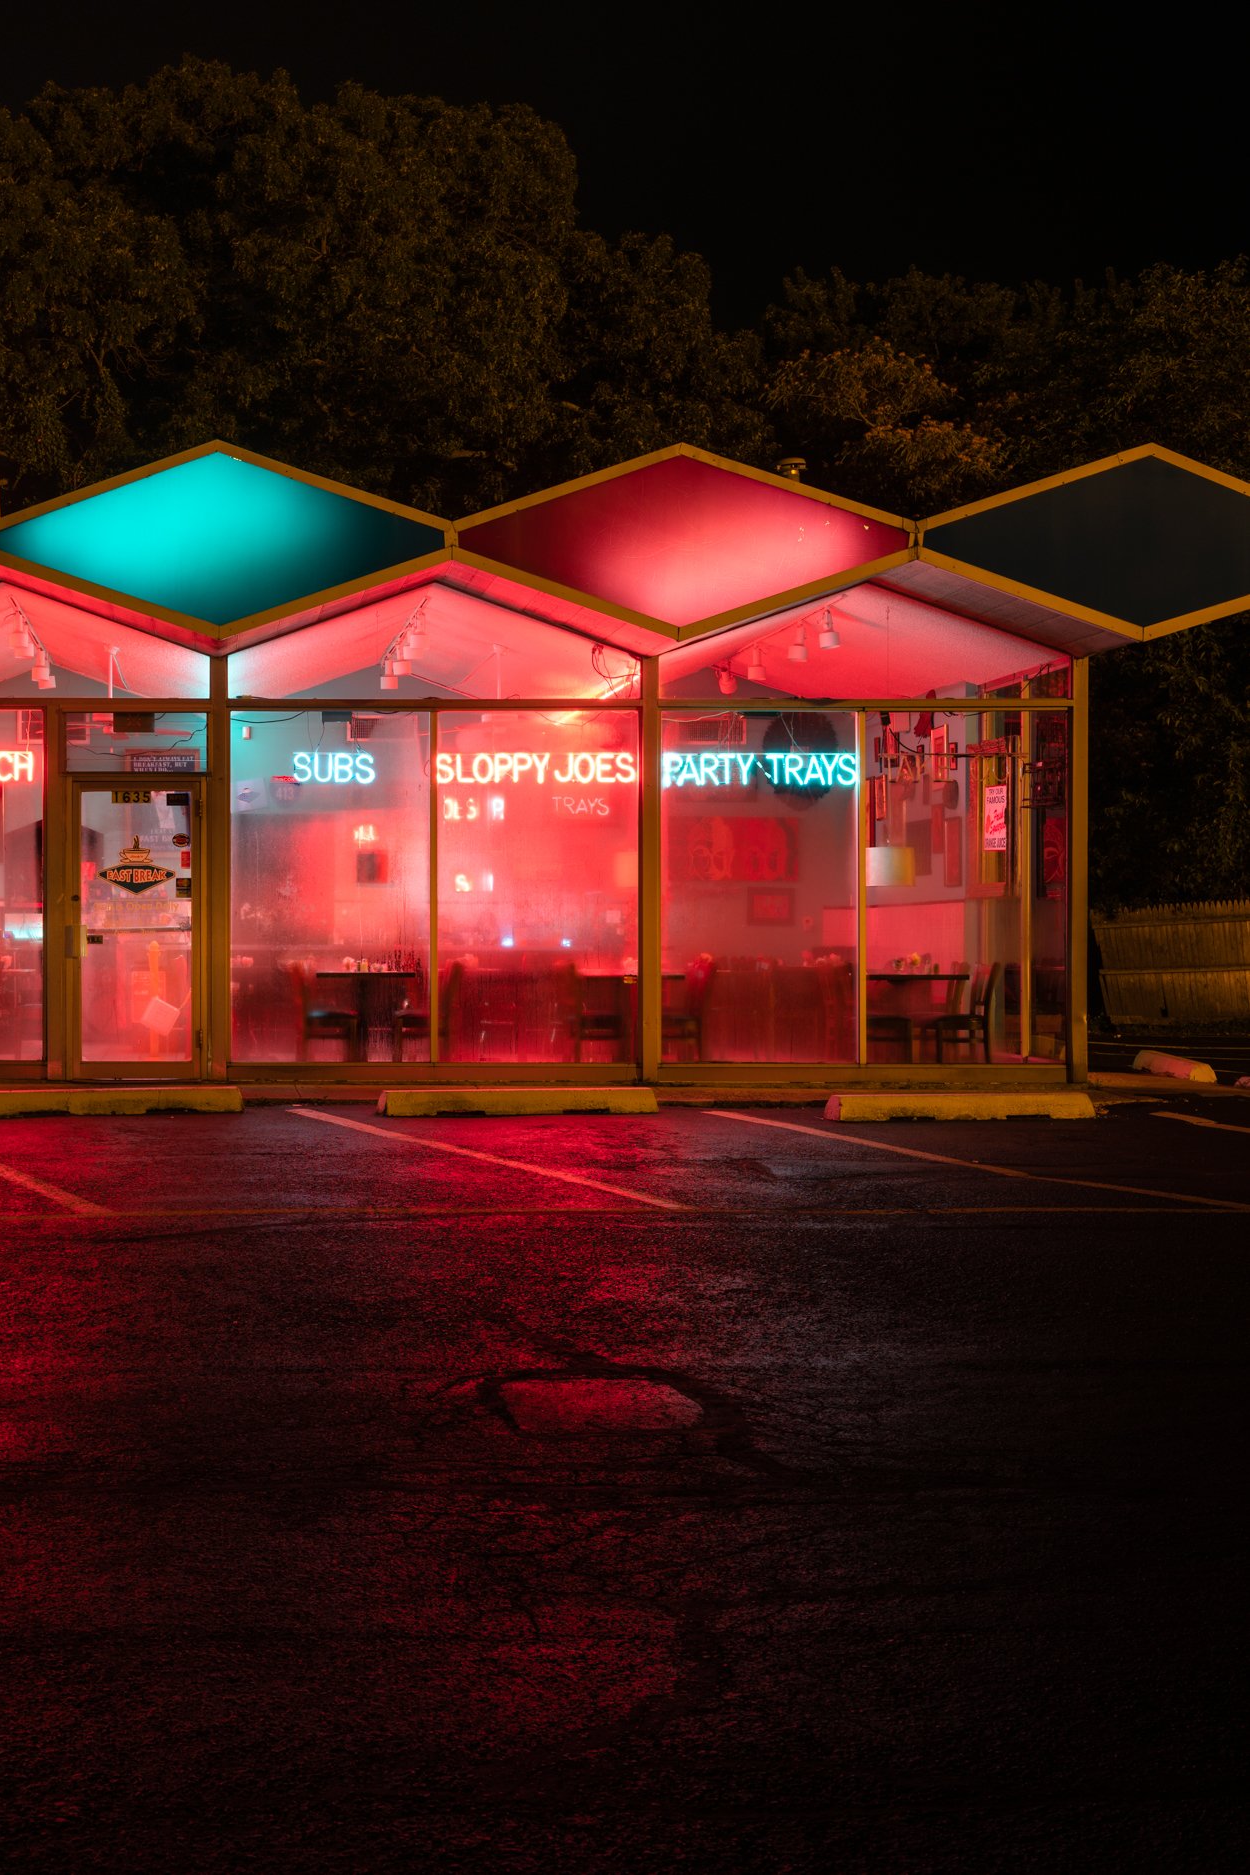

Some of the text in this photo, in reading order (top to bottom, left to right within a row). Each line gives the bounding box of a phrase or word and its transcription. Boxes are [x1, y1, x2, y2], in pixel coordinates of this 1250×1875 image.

[293, 752, 376, 784] SUBS
[436, 753, 636, 784] SLOPPY JOES
[662, 753, 858, 787] PARTY TRAYS
[114, 791, 151, 803] 1635
[552, 796, 610, 816] TRAYS
[986, 795, 1005, 804] FAMOUS
[133, 868, 167, 884] BREAK
